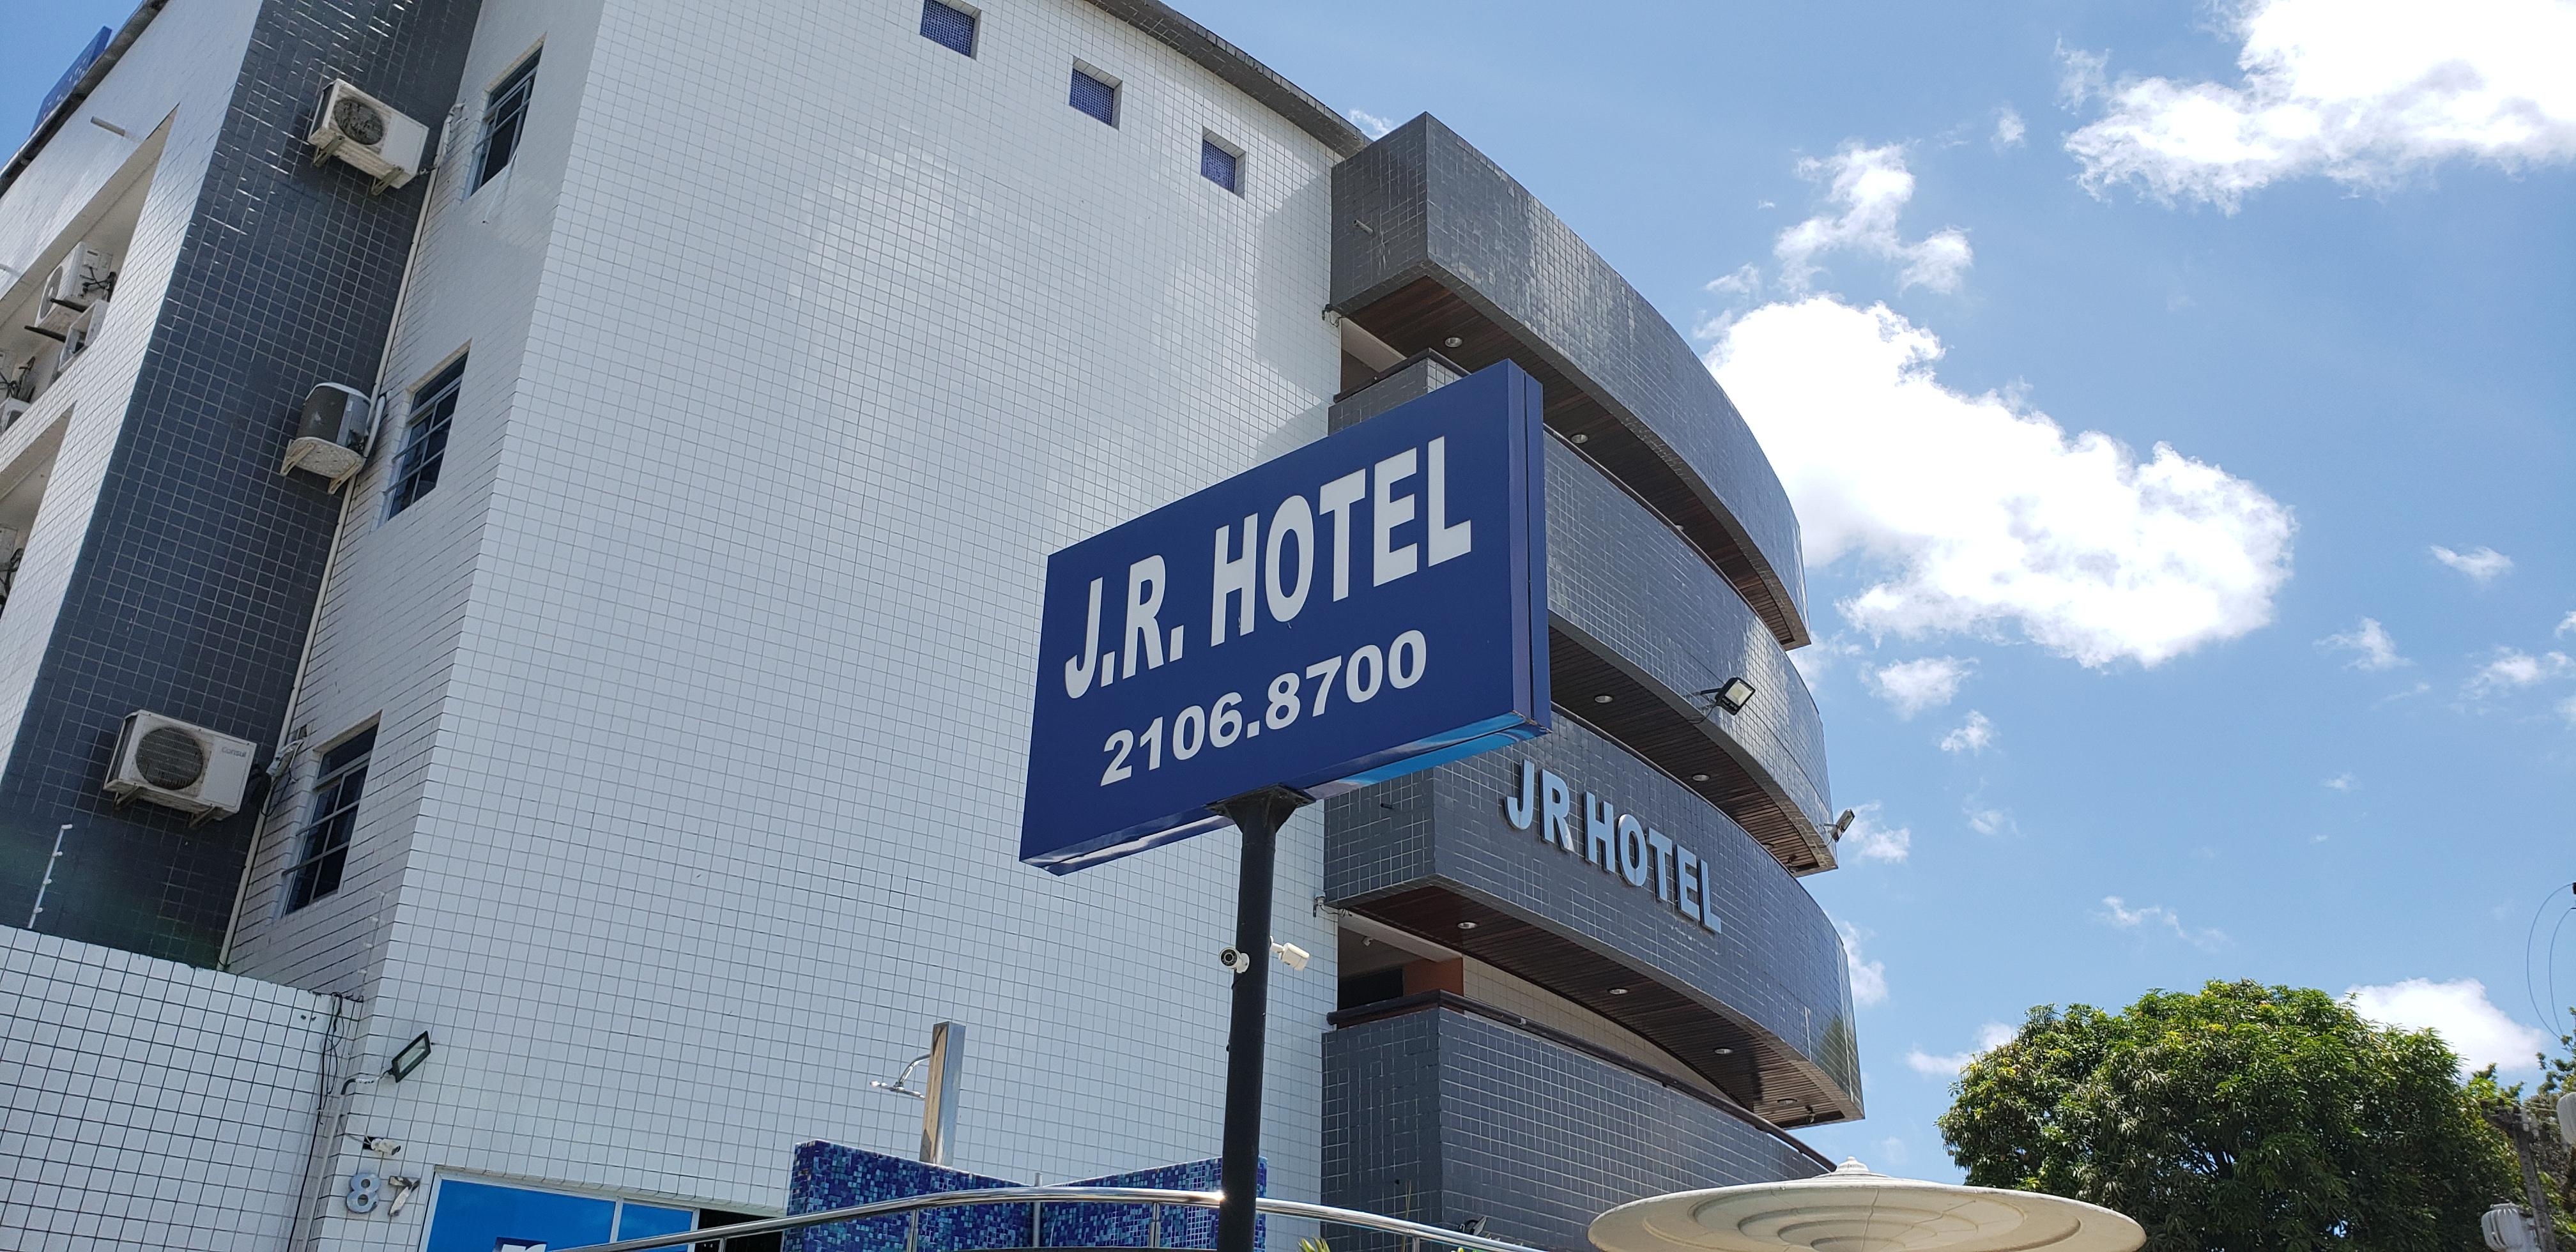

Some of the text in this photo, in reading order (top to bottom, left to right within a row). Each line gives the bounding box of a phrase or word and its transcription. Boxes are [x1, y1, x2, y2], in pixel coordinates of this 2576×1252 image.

[1064, 436, 1472, 699] J.R. HOTEL
[221, 746, 247, 758] Consul
[1100, 630, 1427, 786] 2106.8700
[1505, 759, 1722, 935] JR HOTEL
